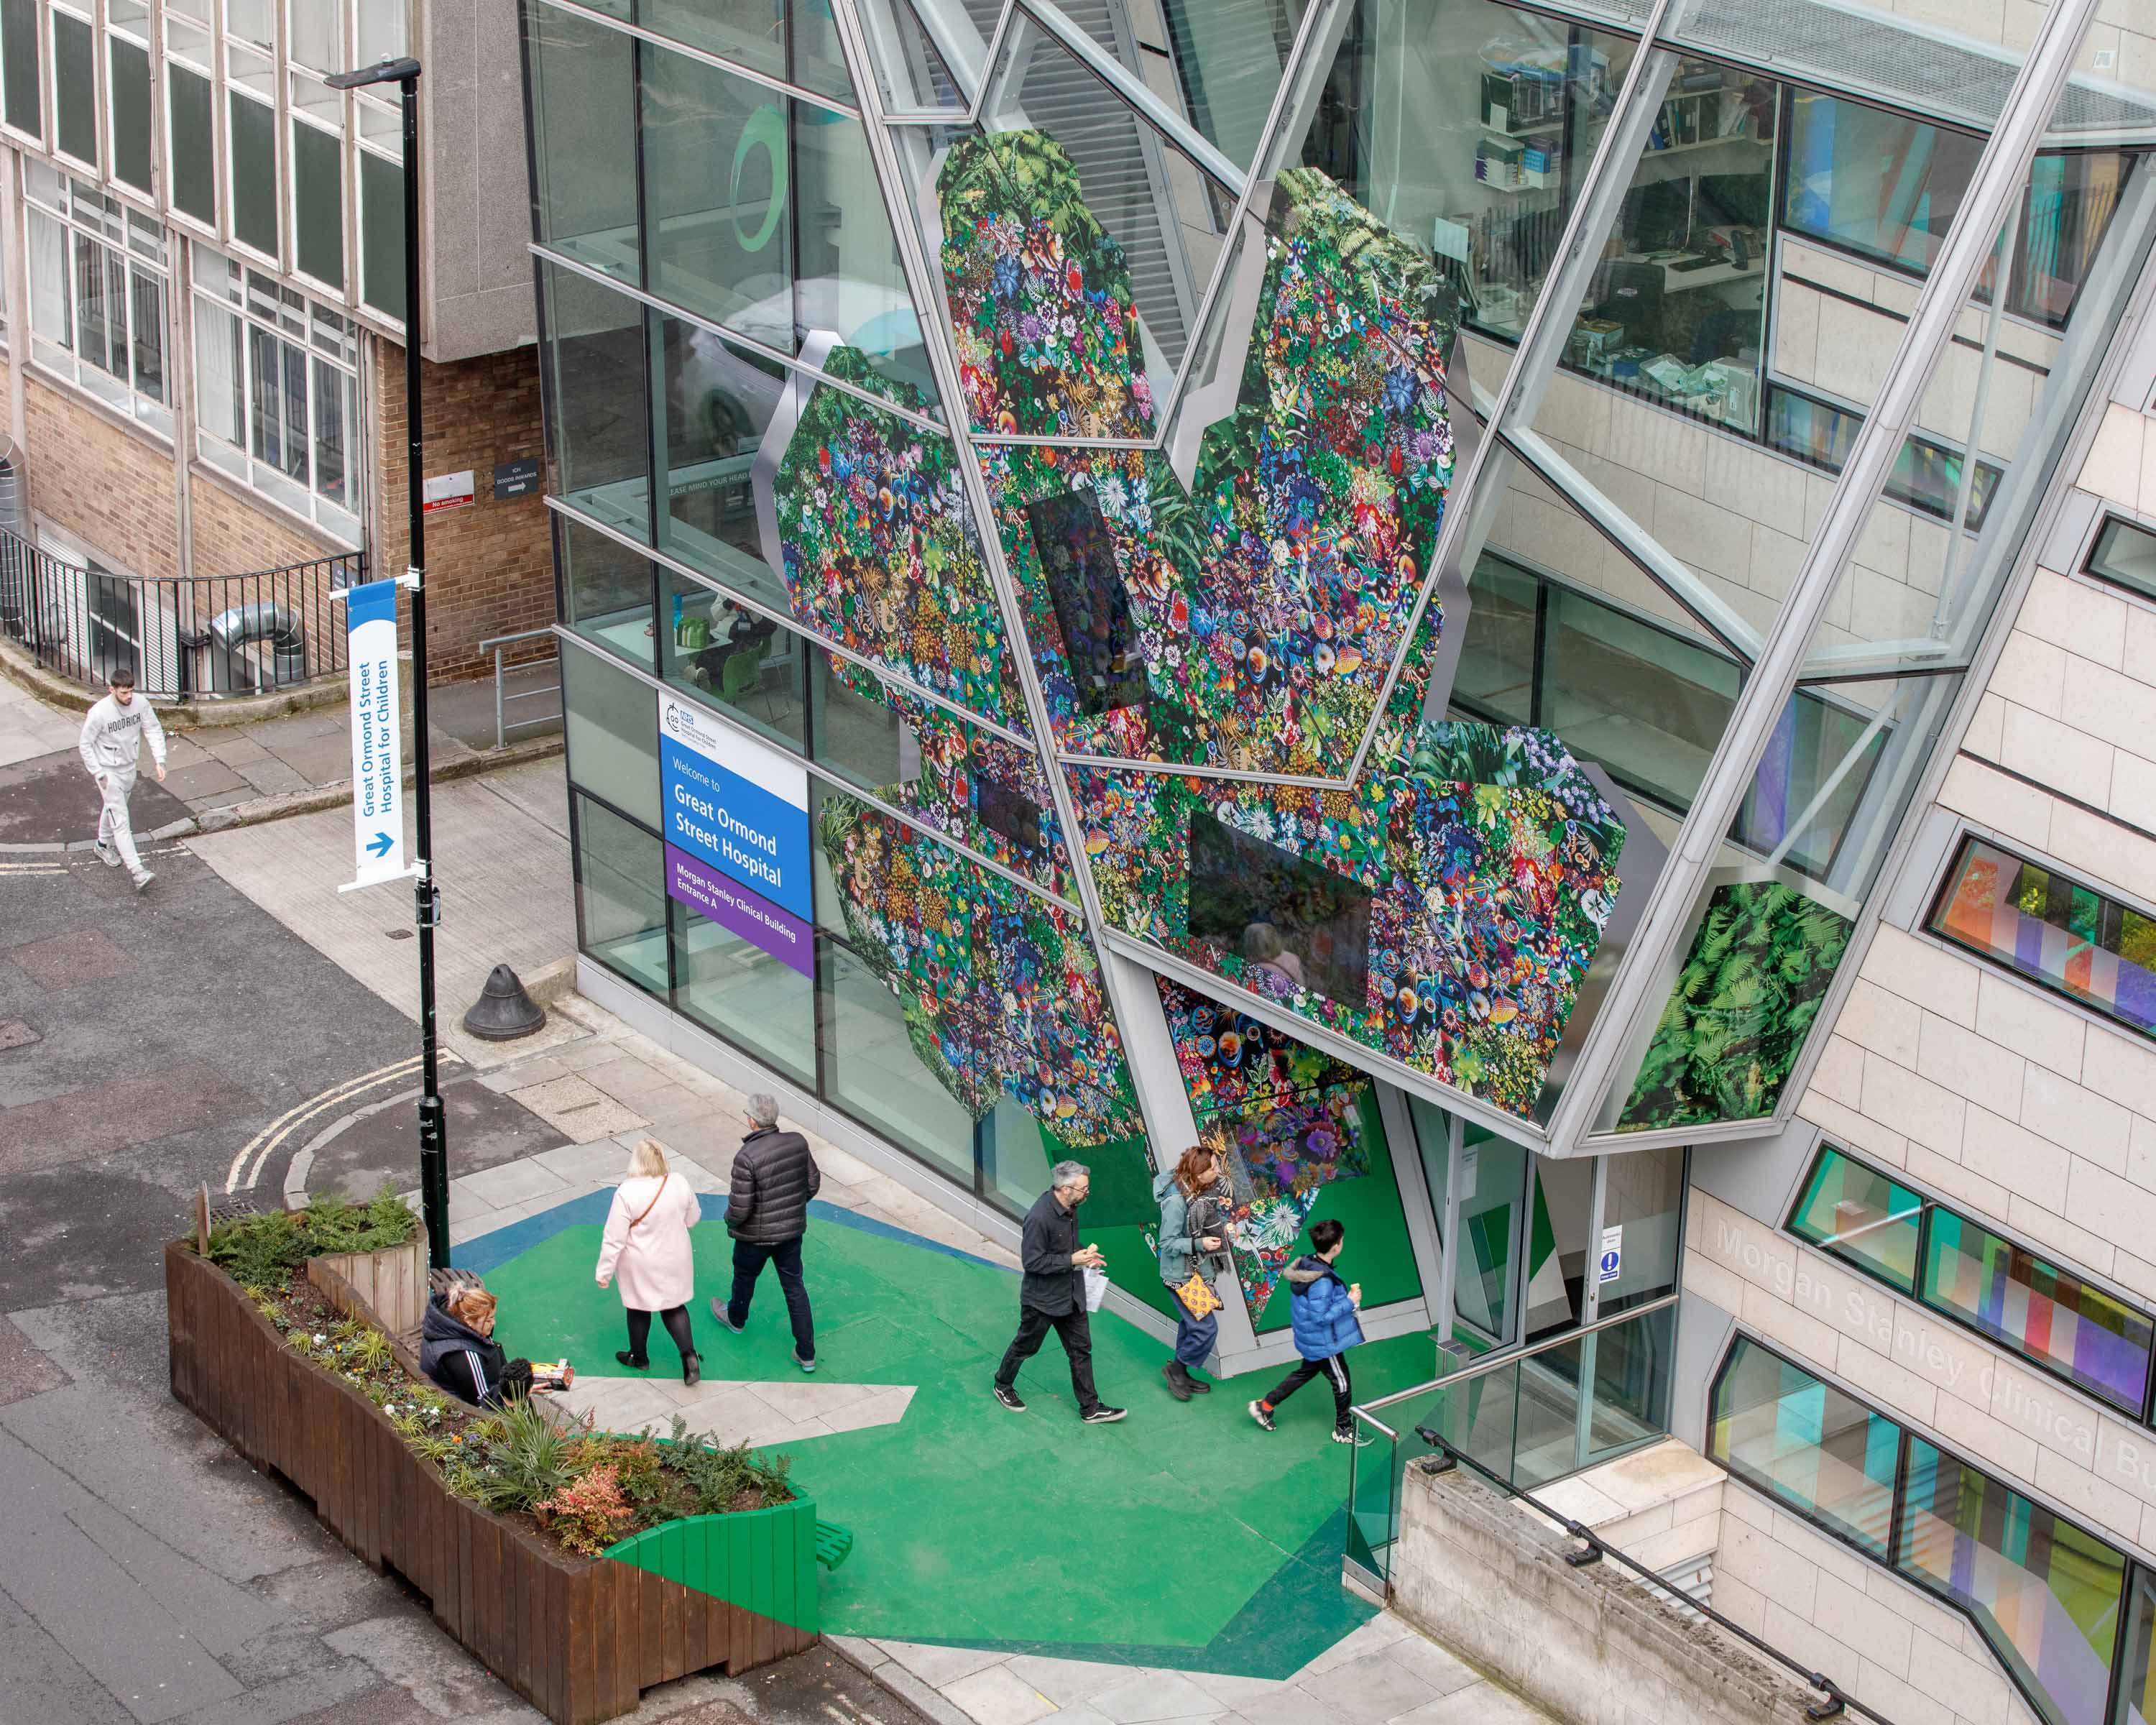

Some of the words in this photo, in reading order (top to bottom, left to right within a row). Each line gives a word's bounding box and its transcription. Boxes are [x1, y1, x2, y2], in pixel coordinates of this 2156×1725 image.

[515, 472, 538, 481] INWARDS
[669, 485, 688, 495] EASE
[688, 482, 707, 492] MIND
[709, 477, 728, 486] YOUR
[729, 472, 747, 481] HEAD
[441, 497, 464, 506] smoking
[359, 662, 371, 707] Street
[376, 660, 389, 722] Children
[108, 713, 141, 733] HOODRICH
[680, 710, 694, 724] NHS
[359, 711, 373, 773] Ormond
[378, 727, 390, 749] for
[379, 753, 395, 813] Hospital
[673, 756, 709, 787] Welcome
[711, 778, 720, 792] to
[363, 776, 374, 817] Great
[675, 783, 714, 822] Great
[717, 807, 777, 857] Ormond
[676, 812, 719, 852] Street
[722, 837, 782, 888] Hospital
[677, 878, 709, 904] Entrance
[711, 898, 717, 909] A
[677, 862, 706, 888] Morgan
[707, 881, 735, 906] Stanley
[736, 898, 763, 922] Clinical
[765, 915, 796, 944] Building
[1716, 1218, 1832, 1309] Morgan
[1845, 1290, 1965, 1386] Stanley
[1979, 1367, 2104, 1460] Clinical
